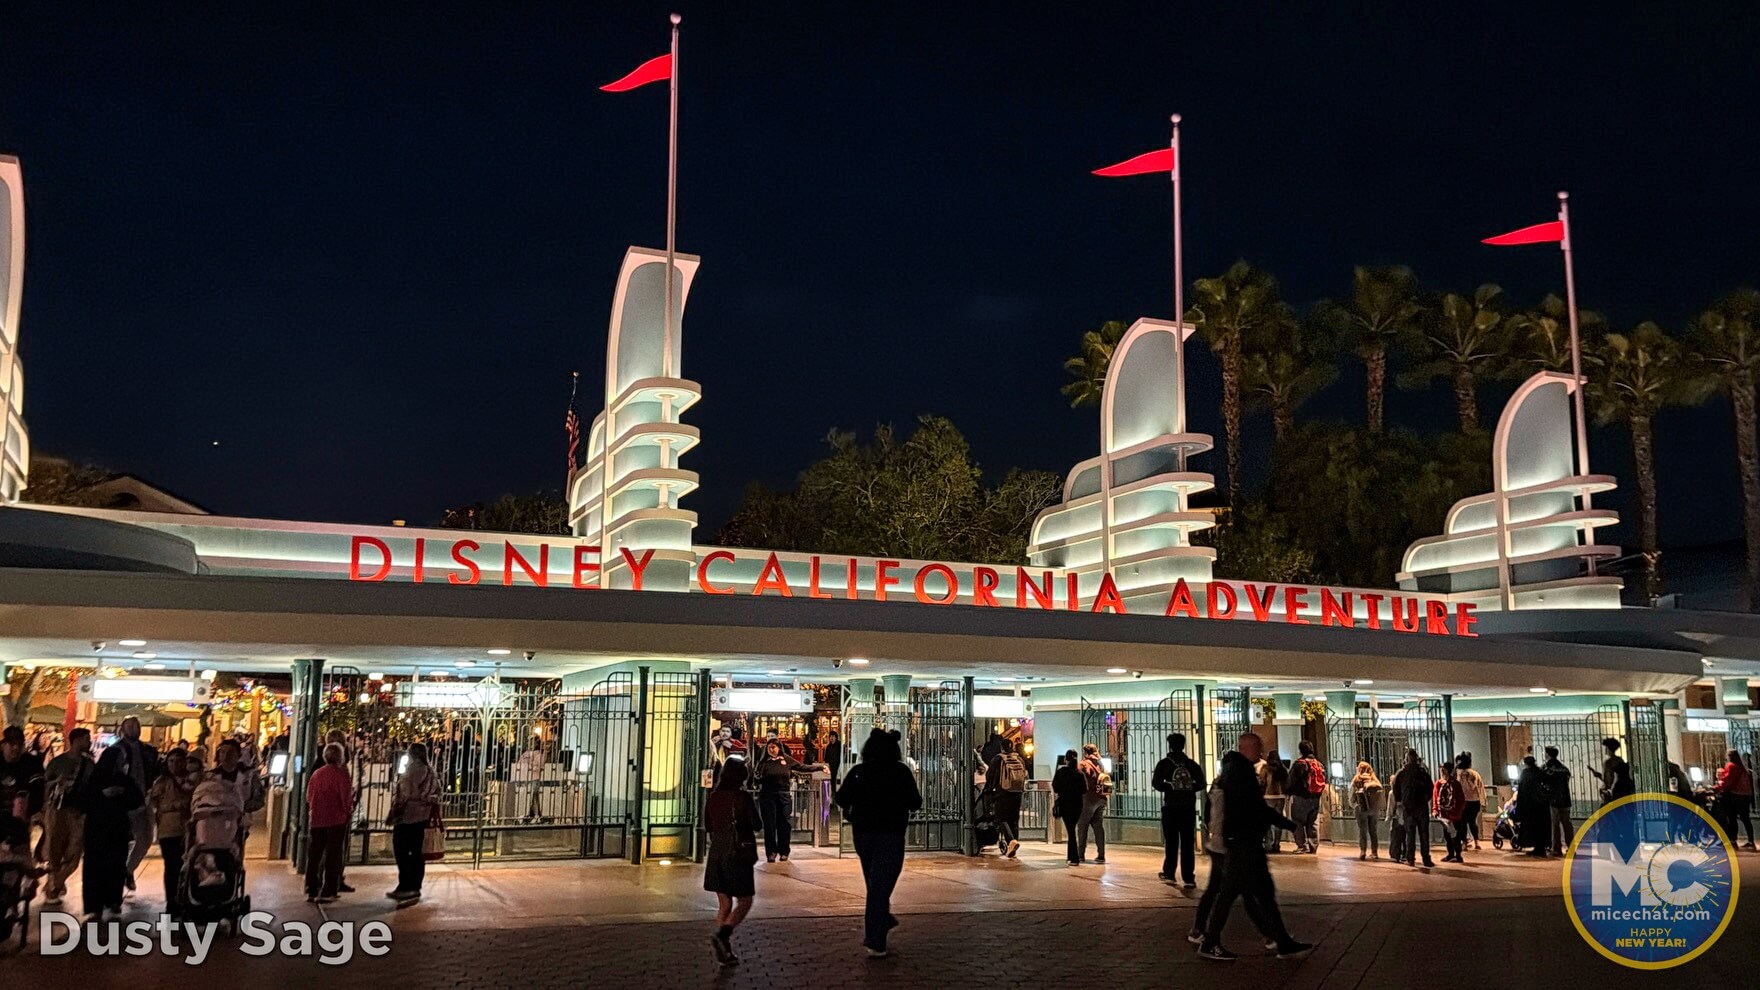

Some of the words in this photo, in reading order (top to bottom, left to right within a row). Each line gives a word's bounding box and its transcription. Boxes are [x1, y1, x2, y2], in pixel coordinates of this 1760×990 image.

[349, 535, 656, 591] DISNEY
[697, 550, 1128, 615] CALIFORNIA
[1165, 577, 1479, 637] ADVENTURE
